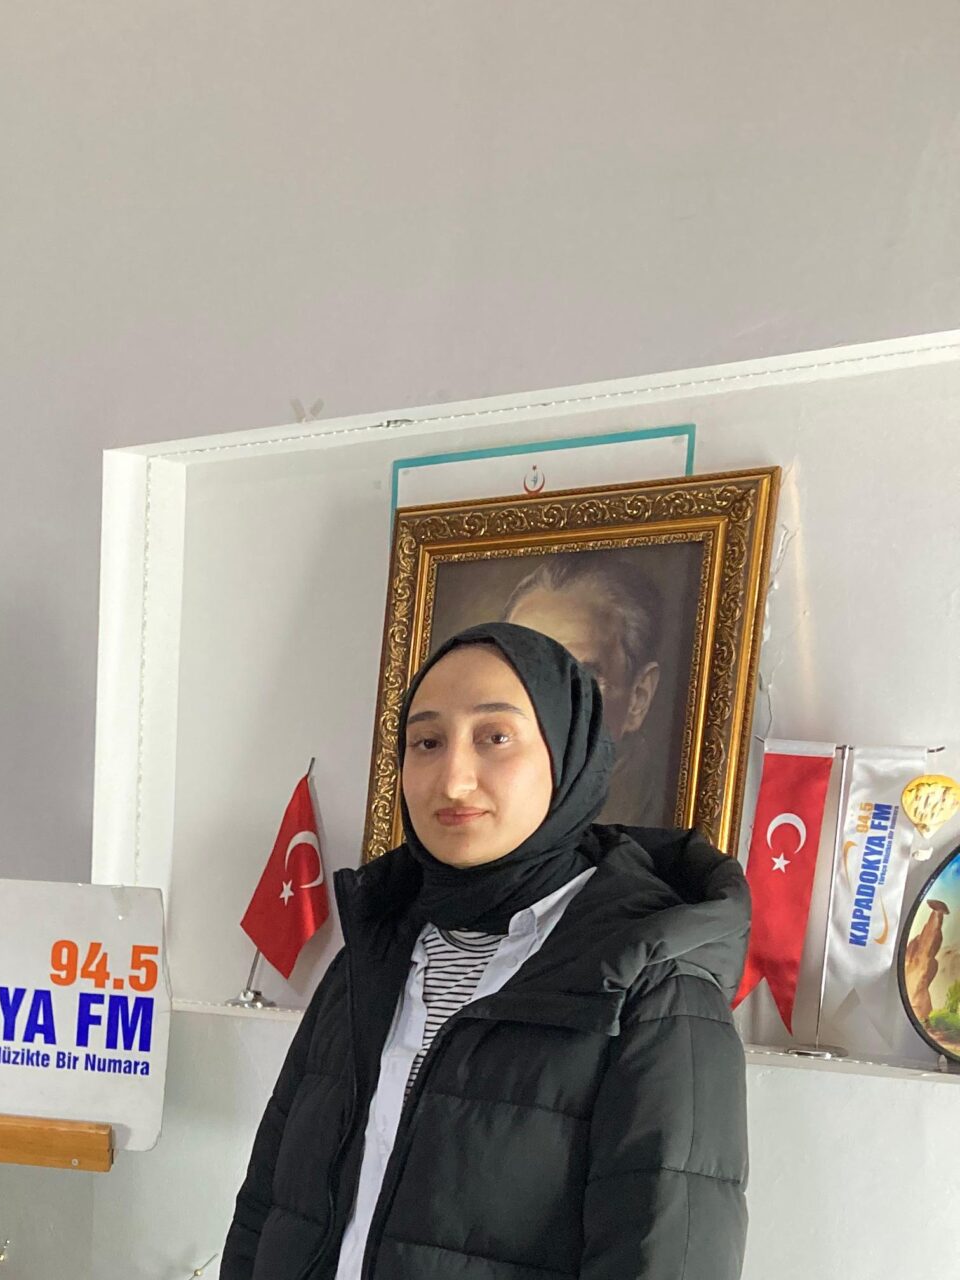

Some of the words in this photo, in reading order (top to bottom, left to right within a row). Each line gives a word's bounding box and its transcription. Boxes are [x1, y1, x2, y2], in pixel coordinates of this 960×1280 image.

[849, 835, 887, 947] KAPADOKYA
[870, 803, 893, 832] FM
[49, 939, 159, 993] 94.5
[76, 992, 155, 1053] FM
[56, 1051, 79, 1070] Bir
[84, 1053, 150, 1076] Numara
